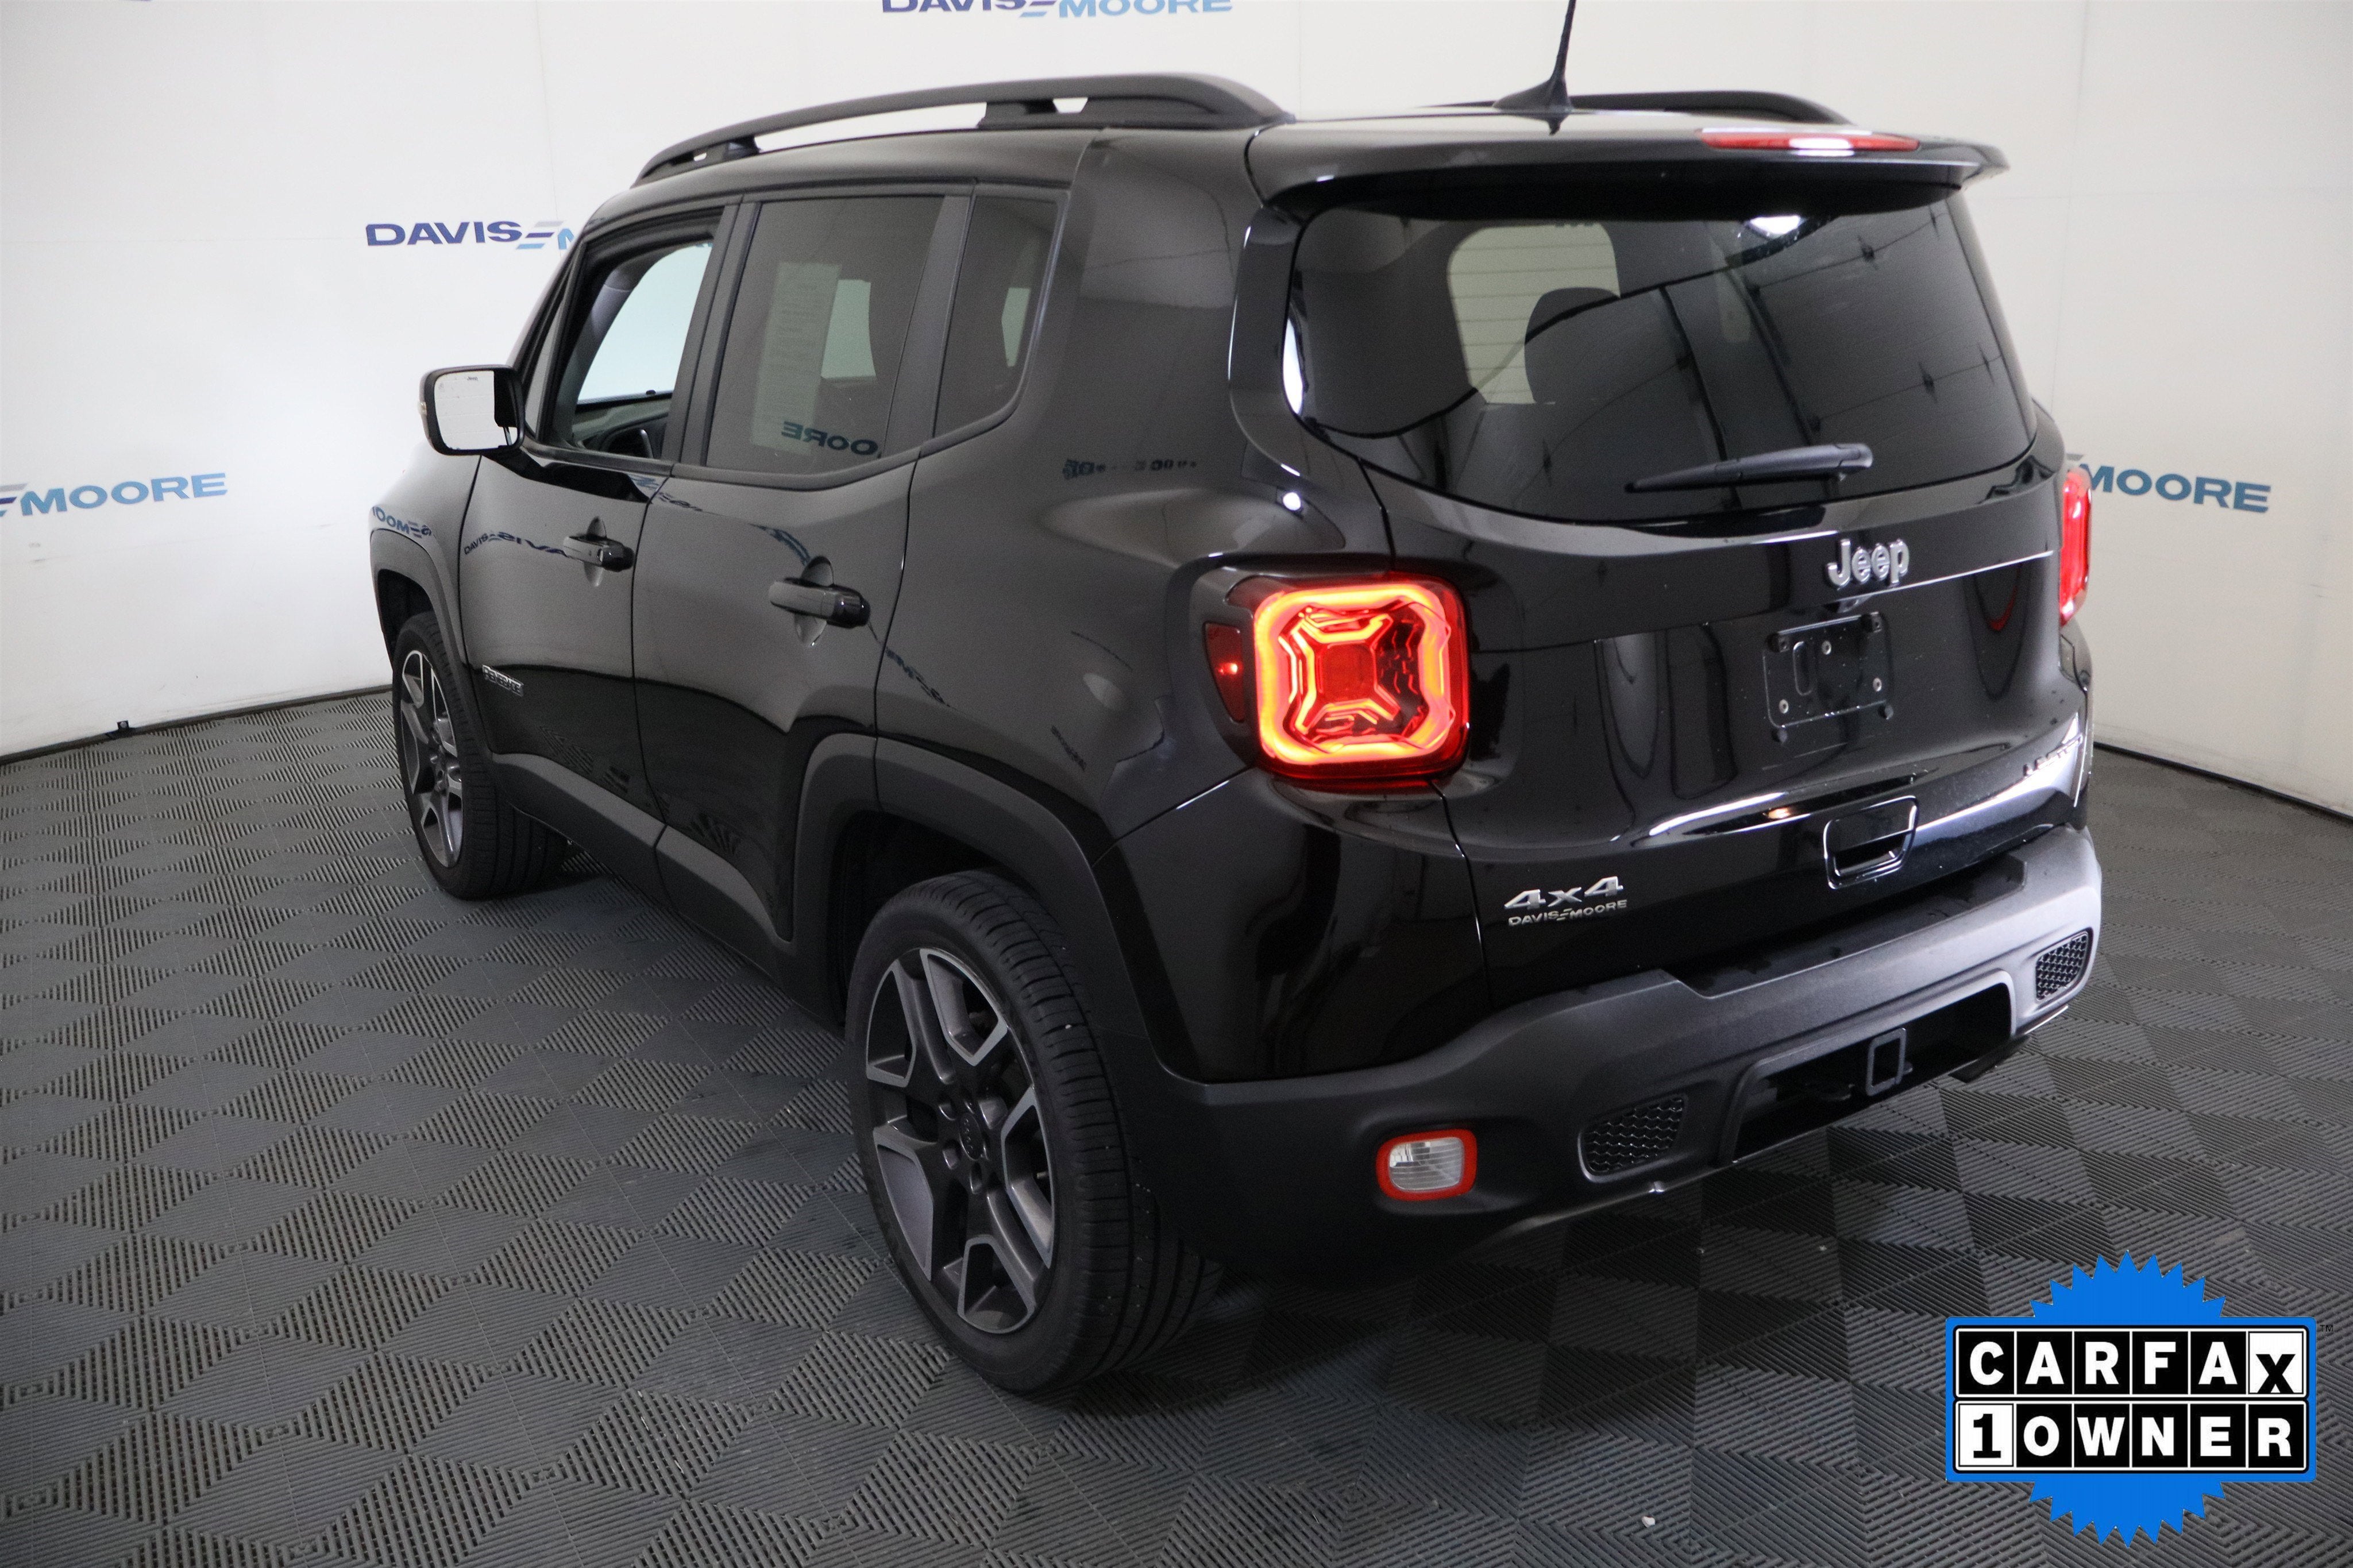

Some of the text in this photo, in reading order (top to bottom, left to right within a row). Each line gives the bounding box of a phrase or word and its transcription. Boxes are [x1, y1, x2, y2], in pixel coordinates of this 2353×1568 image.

[1059, 0, 1233, 17] MOORE
[366, 221, 522, 246] DAVIS
[20, 473, 228, 516] MOORE
[2079, 464, 2271, 513] MOORE
[1827, 539, 1910, 589] Jeep
[1508, 899, 1627, 926] DAVIS MOORE
